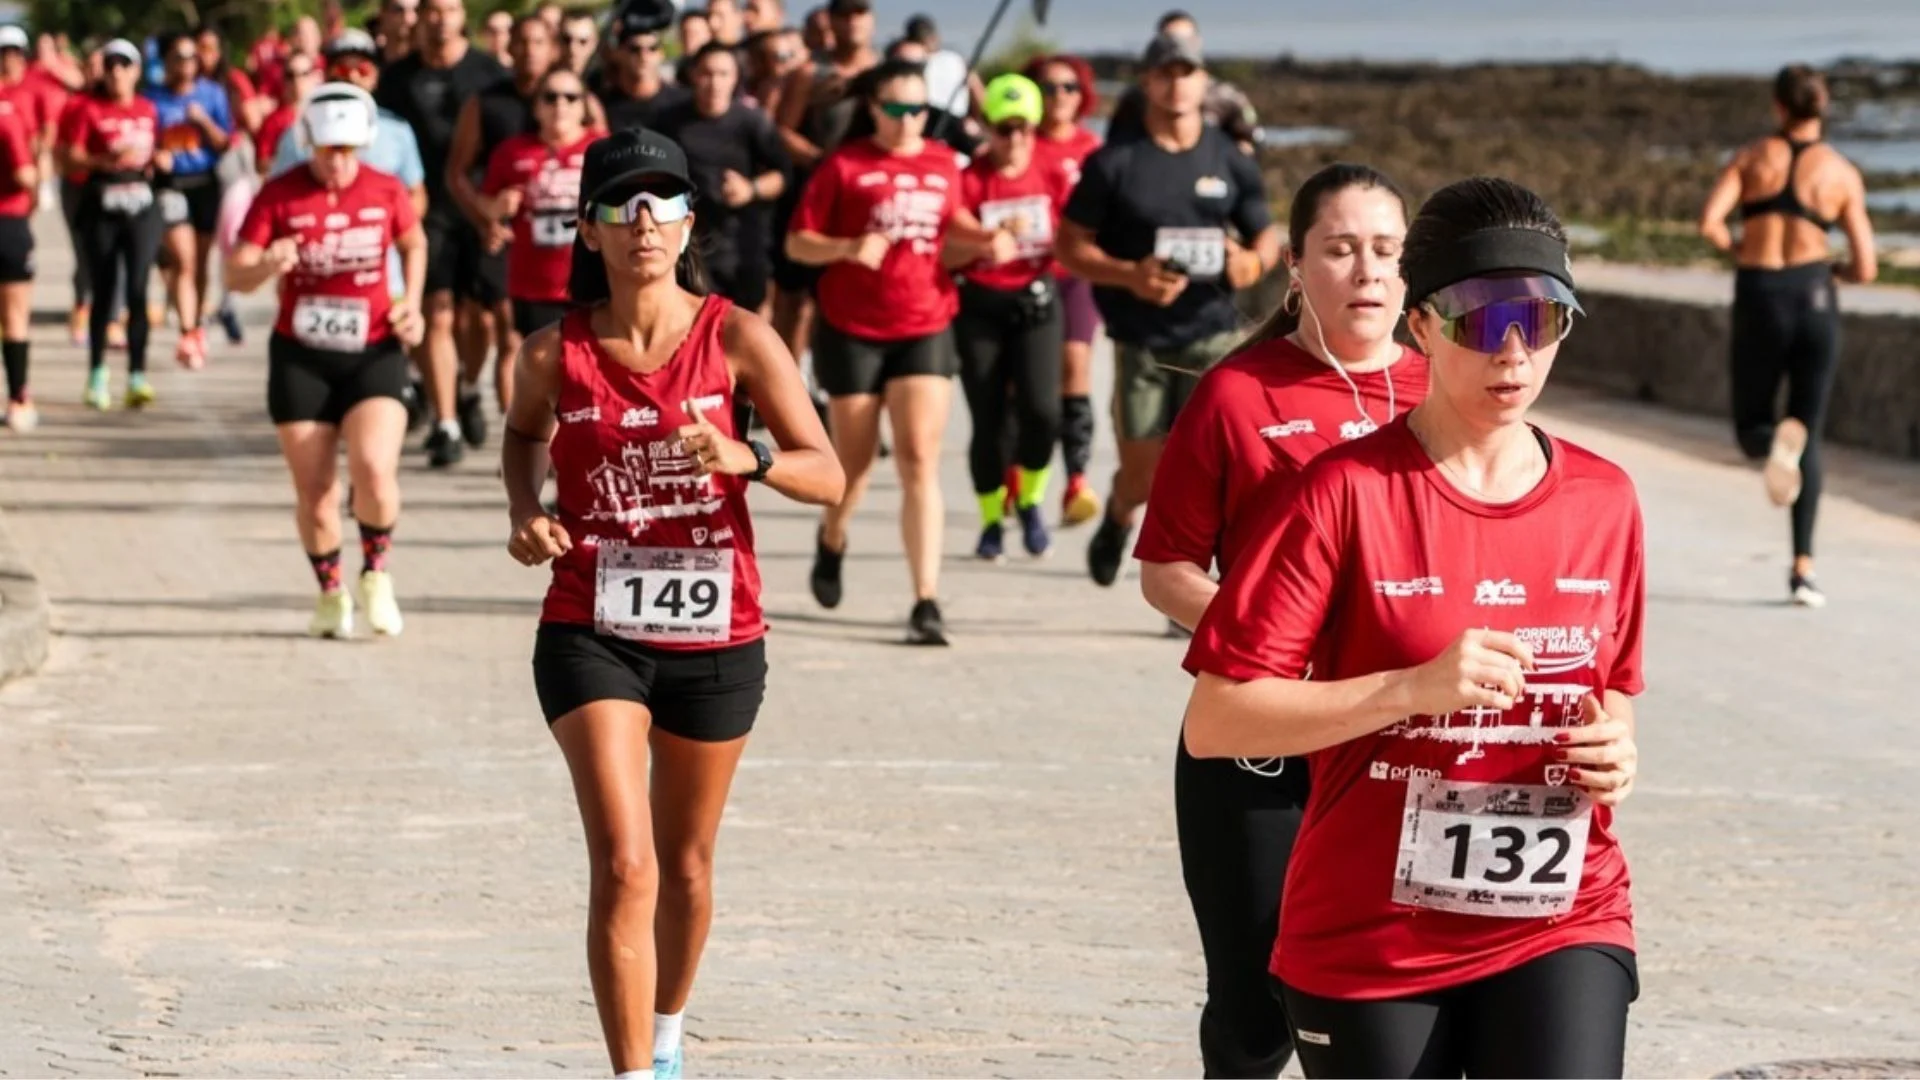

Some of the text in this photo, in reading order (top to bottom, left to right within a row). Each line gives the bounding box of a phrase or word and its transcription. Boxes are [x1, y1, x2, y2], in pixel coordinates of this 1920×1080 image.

[307, 310, 359, 336] 264
[624, 577, 719, 618] 149
[1513, 626, 1586, 640] CORRIDA DE
[1546, 638, 1592, 653] MAGOS
[1444, 823, 1572, 885] 132
